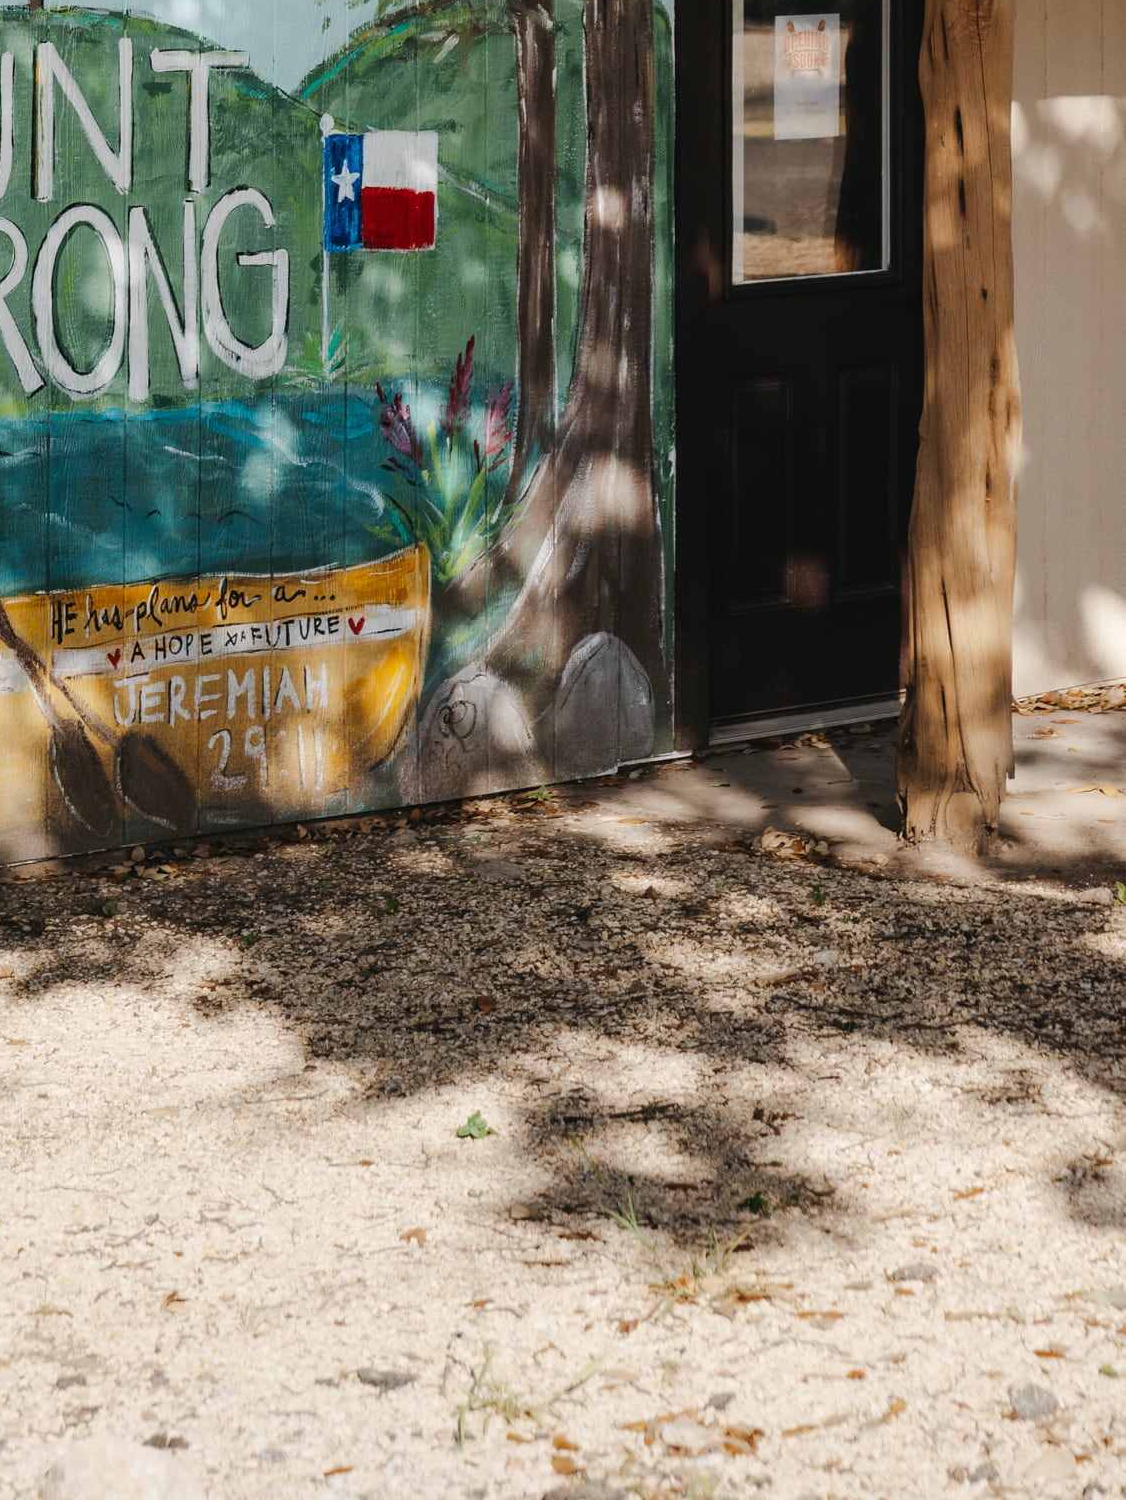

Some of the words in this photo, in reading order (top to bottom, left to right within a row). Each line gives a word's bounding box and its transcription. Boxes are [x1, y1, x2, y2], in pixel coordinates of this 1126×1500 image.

[784, 30, 828, 52] OPENING
[793, 51, 820, 69] SOON
[50, 599, 77, 645] HE
[85, 594, 124, 638] has
[133, 582, 212, 635] plans
[215, 576, 262, 621] for
[130, 642, 146, 664] A
[155, 632, 213, 661] HOPE
[250, 615, 340, 647] FUTURE
[113, 662, 329, 727] JEREMIAH
[208, 723, 324, 793] 29:11
